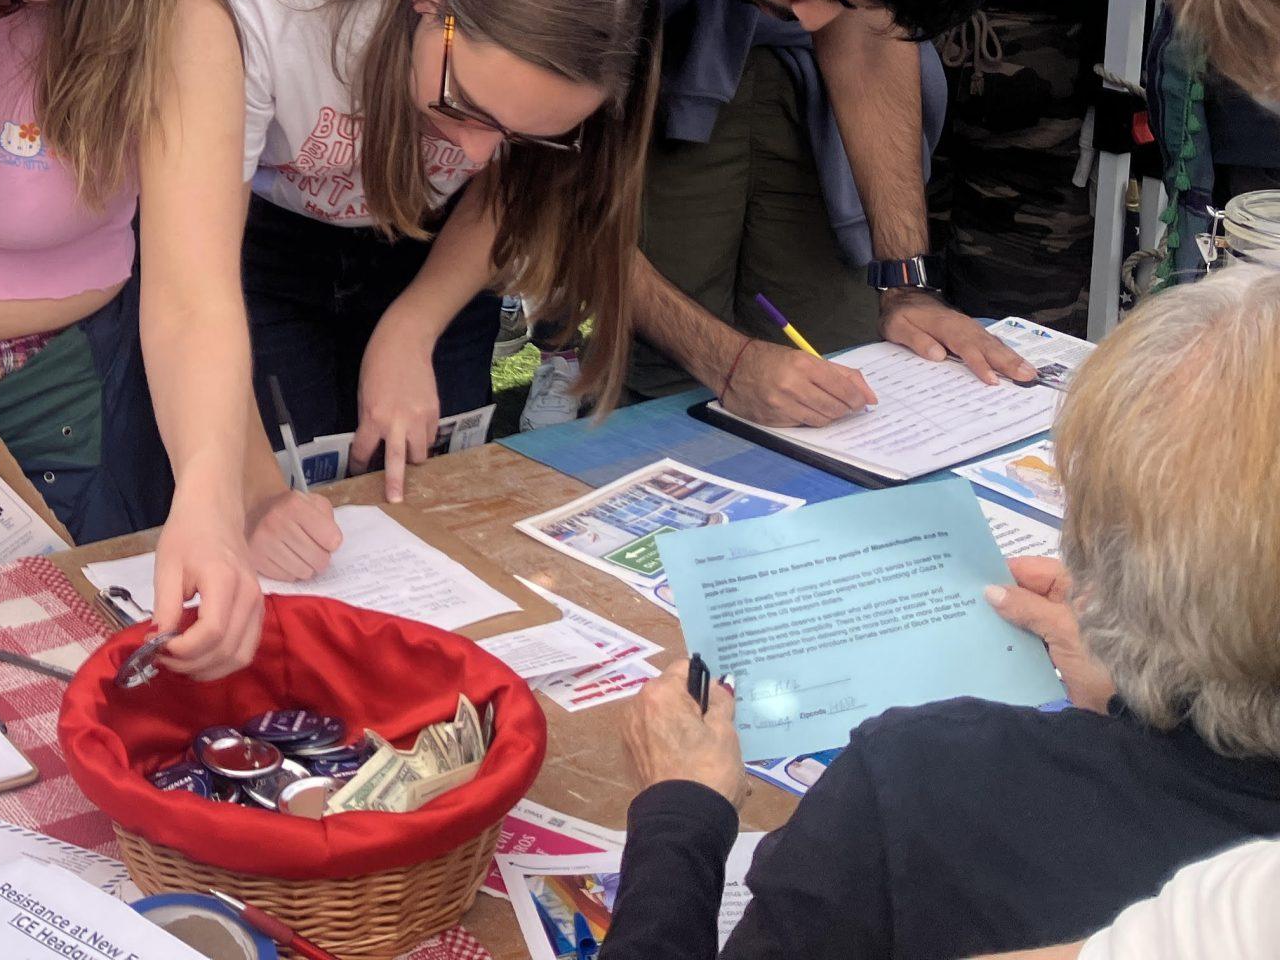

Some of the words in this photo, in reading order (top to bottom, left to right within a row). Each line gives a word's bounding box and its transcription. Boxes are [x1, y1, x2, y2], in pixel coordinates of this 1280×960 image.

[9, 911, 40, 934] ICE
[70, 924, 88, 940] at
[86, 930, 125, 959] New
